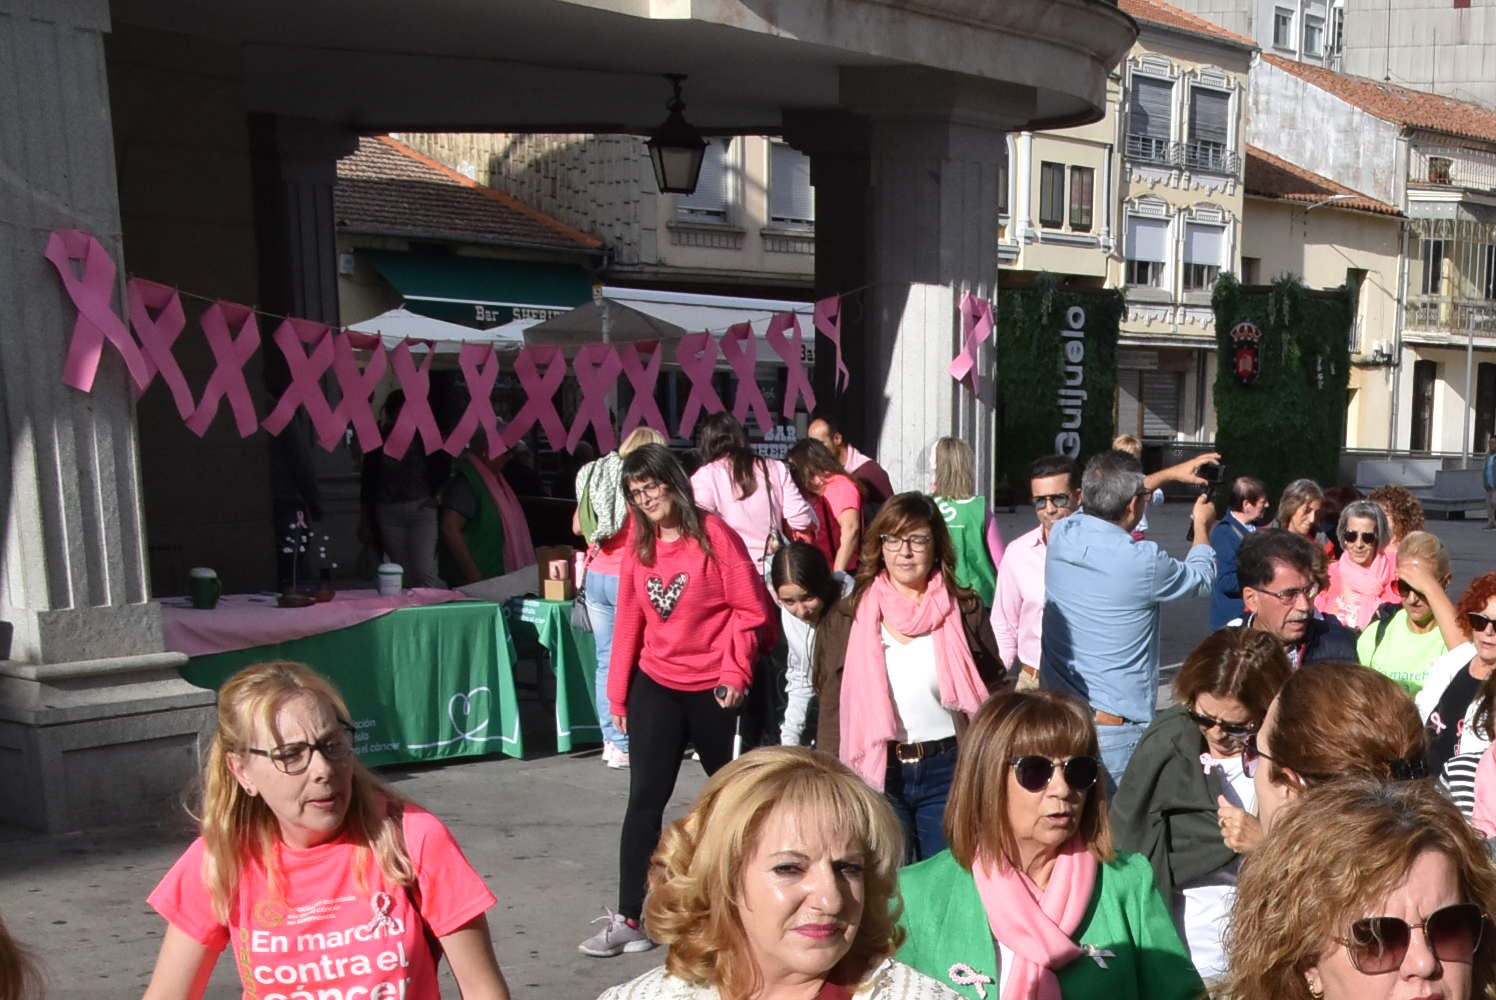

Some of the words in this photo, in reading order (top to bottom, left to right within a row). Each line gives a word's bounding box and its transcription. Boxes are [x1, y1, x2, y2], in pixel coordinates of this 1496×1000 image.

[474, 305, 499, 321] Bar
[1055, 305, 1088, 460] Guijuelo
[252, 930, 288, 953] En
[253, 954, 373, 985] contra
[376, 941, 410, 971] el
